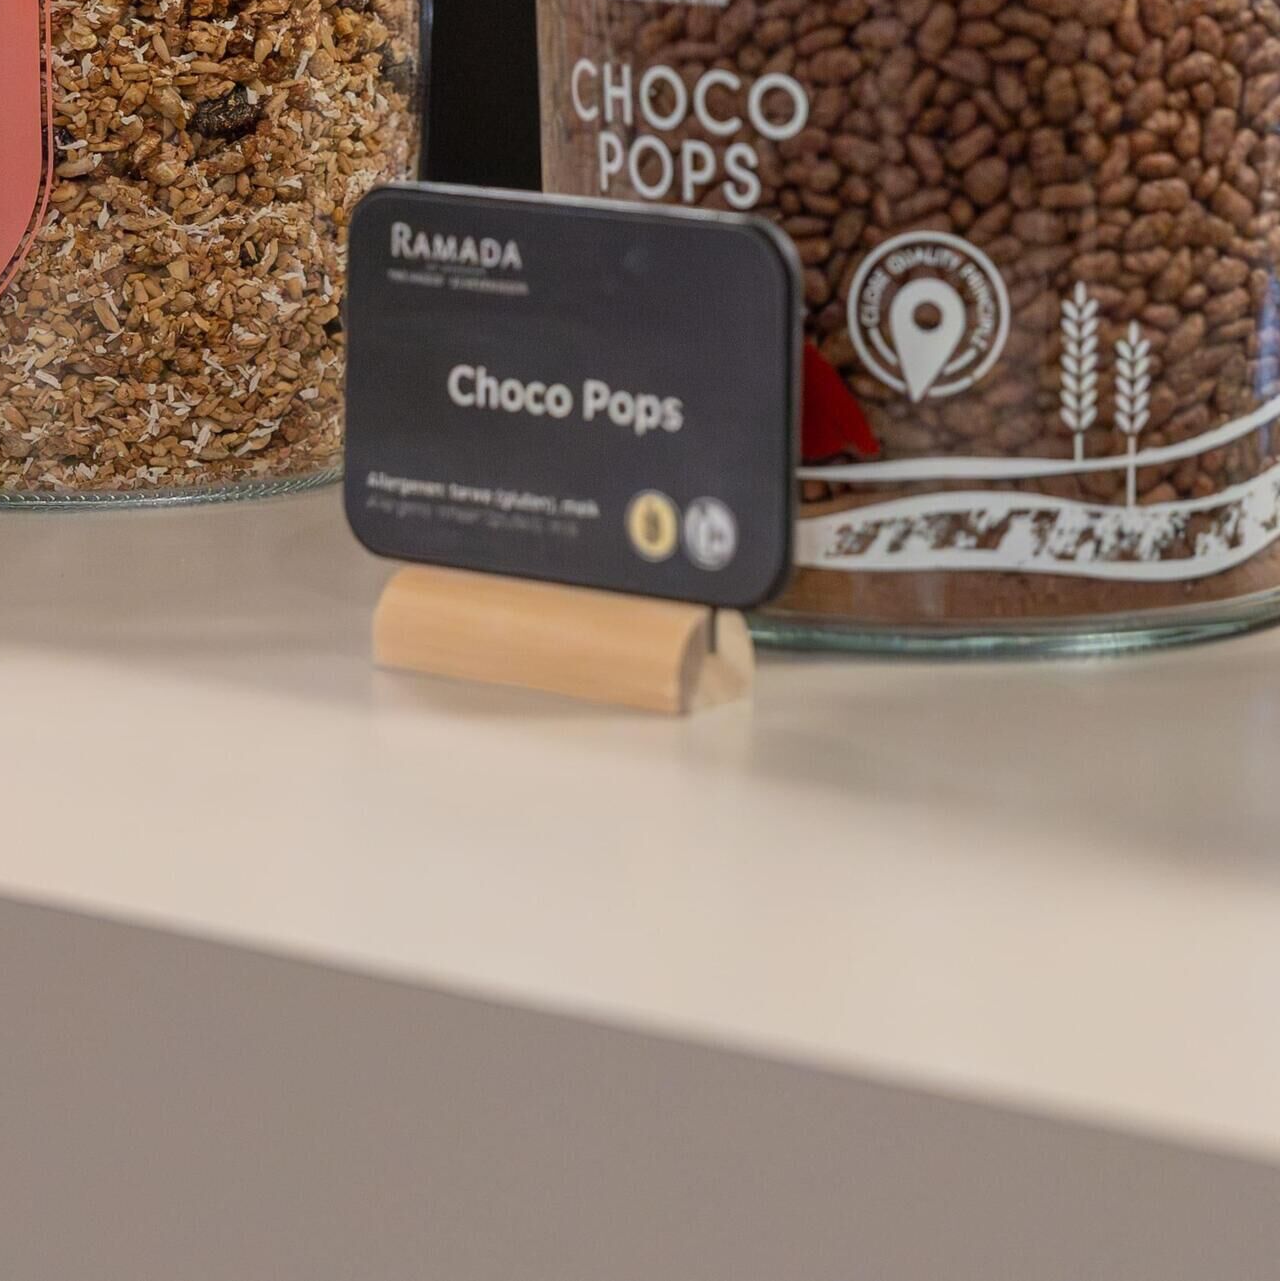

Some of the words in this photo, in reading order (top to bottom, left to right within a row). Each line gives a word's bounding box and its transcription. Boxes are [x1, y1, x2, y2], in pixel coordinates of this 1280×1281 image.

[571, 58, 809, 140] CHOCO
[598, 131, 761, 210] POPS
[390, 221, 523, 270] RAMADA
[447, 364, 573, 419] Choco
[583, 379, 684, 436] Pops
